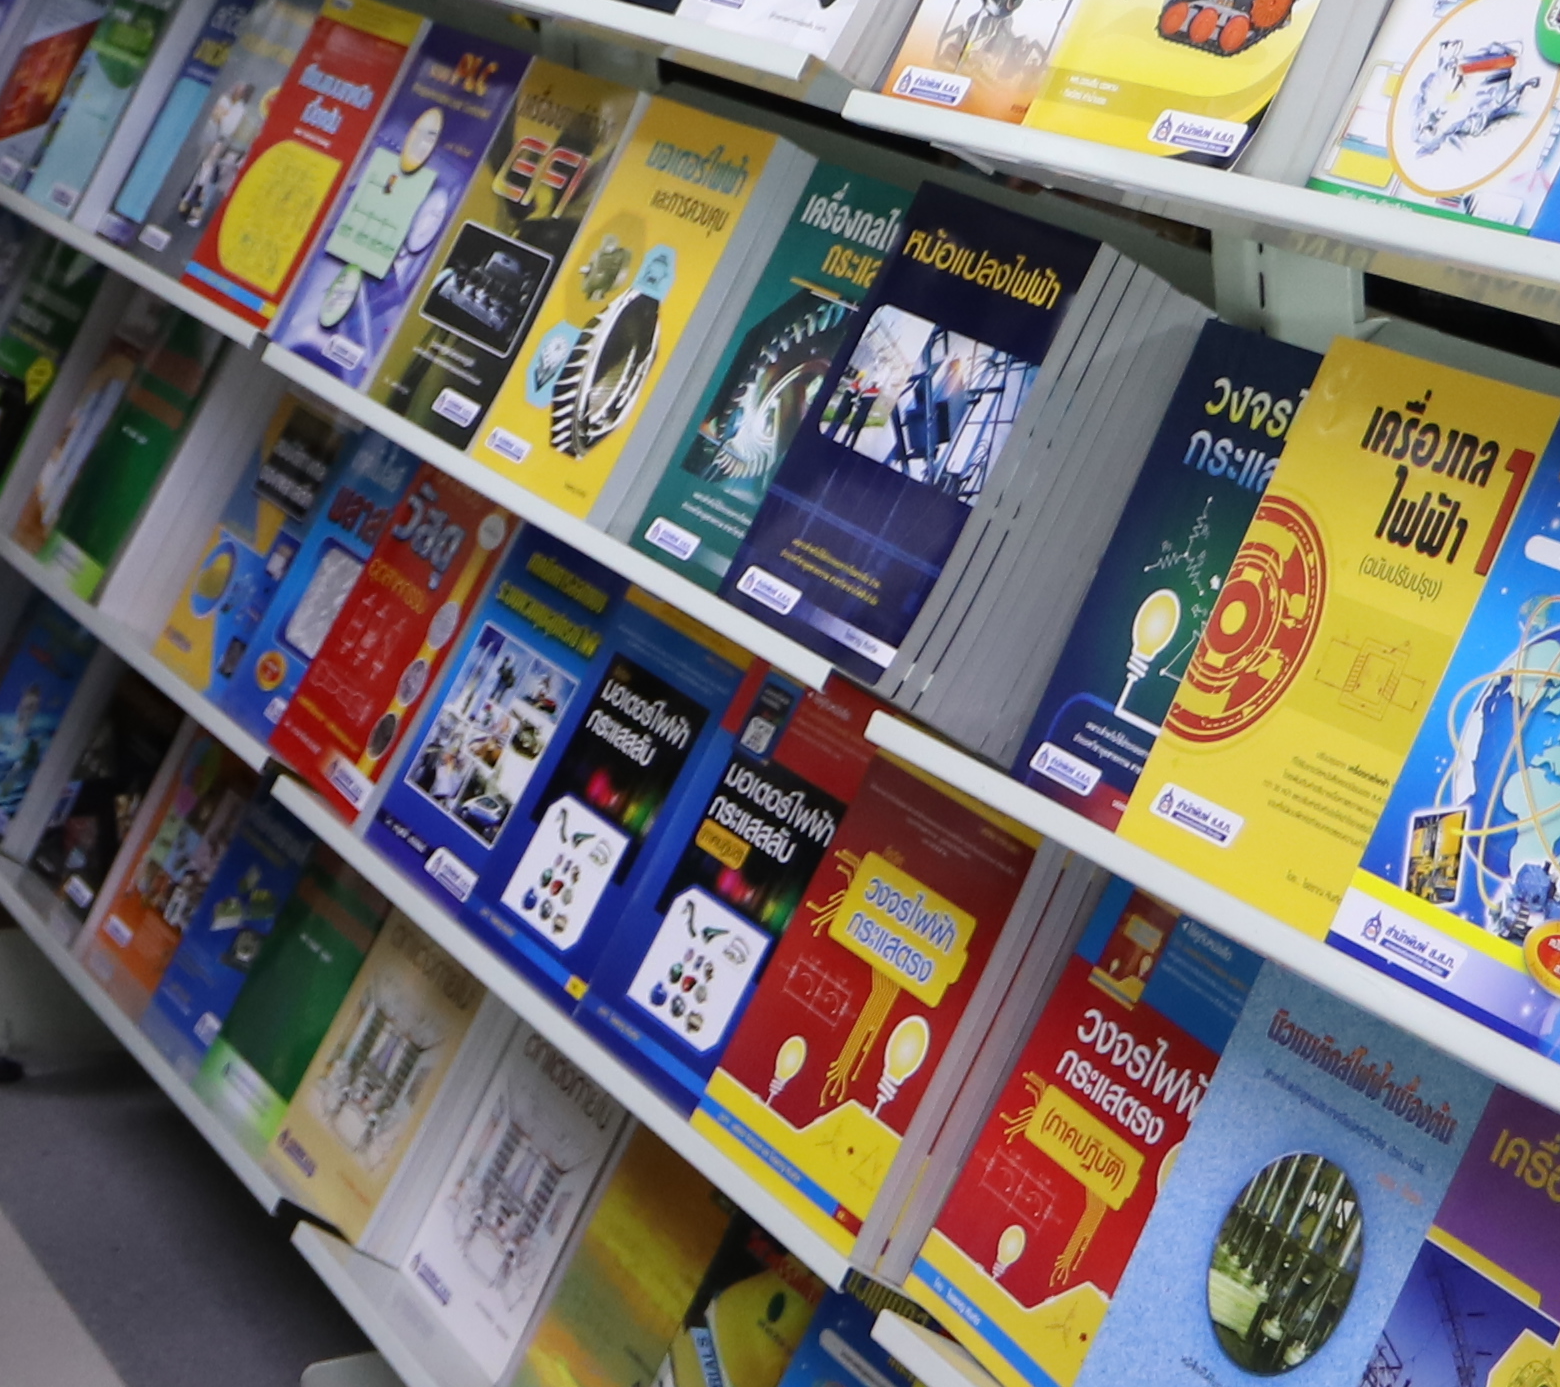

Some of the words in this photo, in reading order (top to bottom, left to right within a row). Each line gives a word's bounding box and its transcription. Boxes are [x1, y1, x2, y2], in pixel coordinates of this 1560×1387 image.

[650, 188, 730, 239] และการควบคุม
[800, 182, 900, 251] เครื่องกลไ
[902, 229, 1063, 312] หม้อแปลงไฟฟ้า
[1359, 388, 1501, 489] เครื่องกล
[1474, 448, 1536, 576] 1
[1374, 463, 1469, 565] ไฟฟ้า
[1357, 552, 1443, 602] (ฉบับปรับปรุง)
[584, 707, 656, 768] กระแสสลับ
[598, 676, 691, 750] มอเตอร์ไฟฟ้า
[706, 794, 798, 866] กระแสสลับ
[722, 760, 838, 848] มอเตอร์ไฟฟ้า
[844, 911, 935, 985] กระแสตรง
[863, 877, 958, 955] วงจรไฟฟ้า
[1385, 924, 1429, 953] สำนักพิมพ์
[1429, 945, 1456, 970] ส.ส.ท.
[1055, 1048, 1166, 1147] กระแสตรง
[1076, 1008, 1211, 1126] วงจรไฟฟ้
[1040, 1107, 1128, 1189] (ภาคปฏิบัติ)
